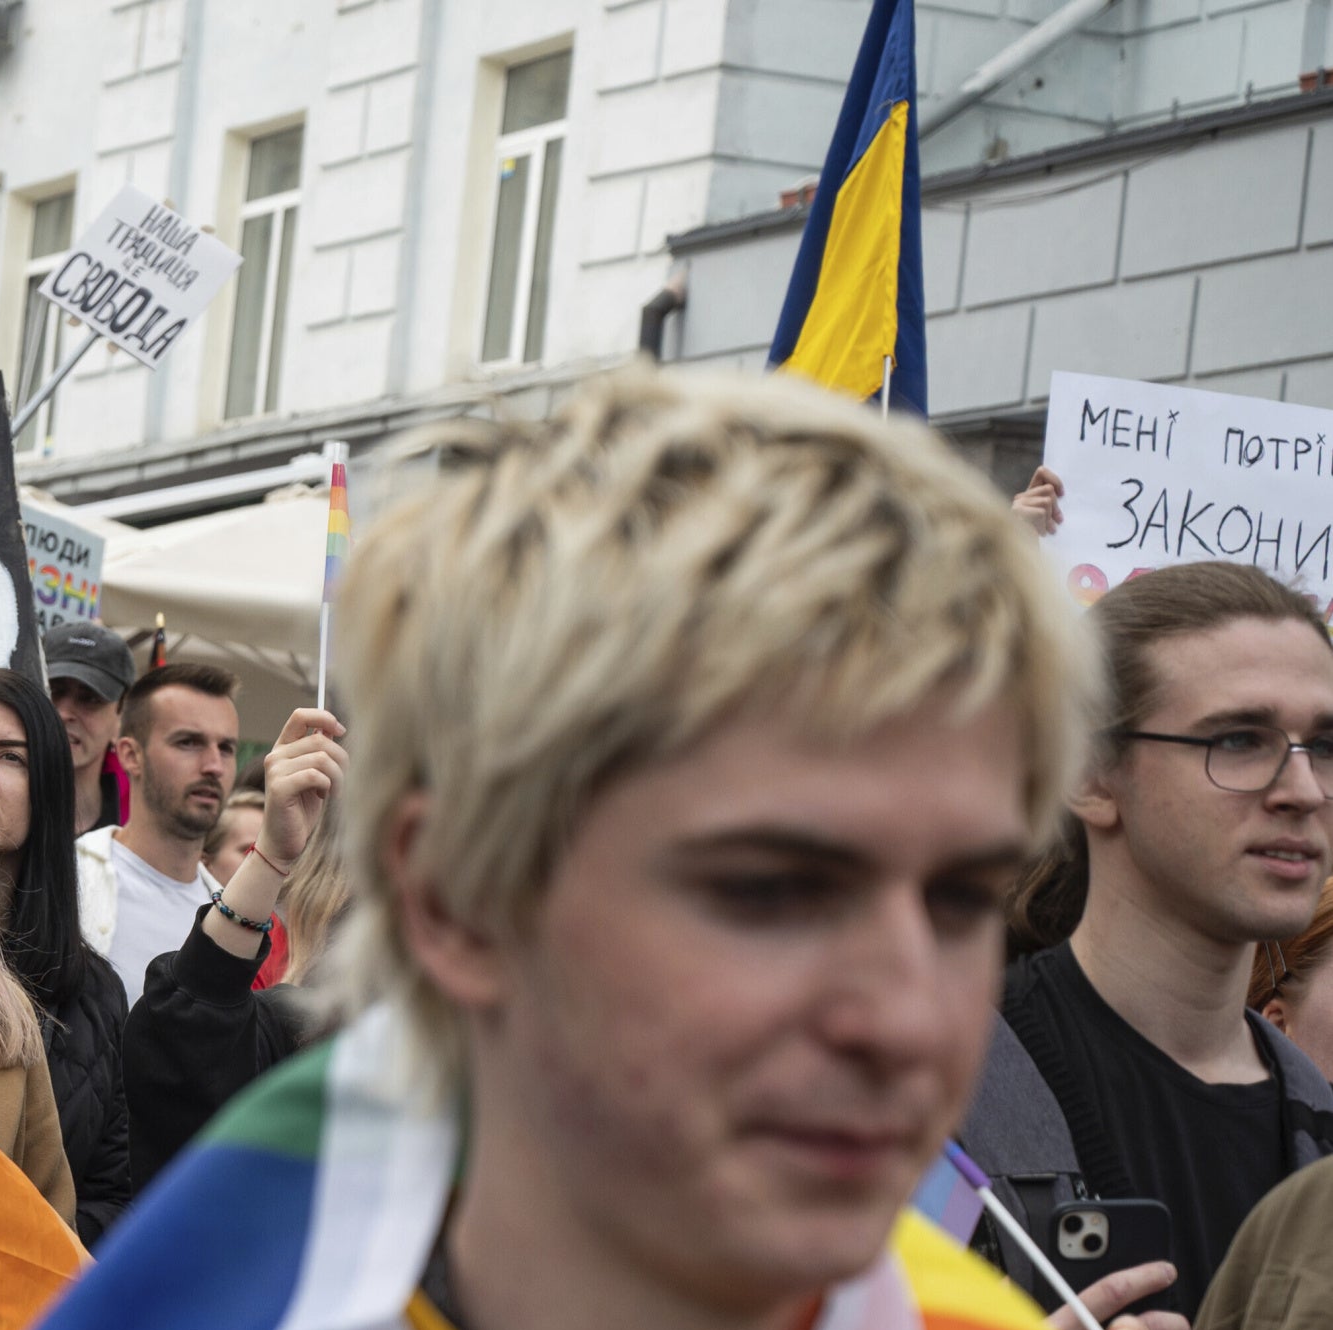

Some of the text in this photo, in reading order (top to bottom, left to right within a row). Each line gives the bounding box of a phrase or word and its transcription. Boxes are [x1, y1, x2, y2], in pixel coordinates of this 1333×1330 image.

[139, 203, 200, 257] НАША
[52, 252, 188, 360] СВОБОДА
[1079, 398, 1333, 476] МЕНІ ПОТРІ
[1107, 478, 1332, 581] ЗАКОНИ
